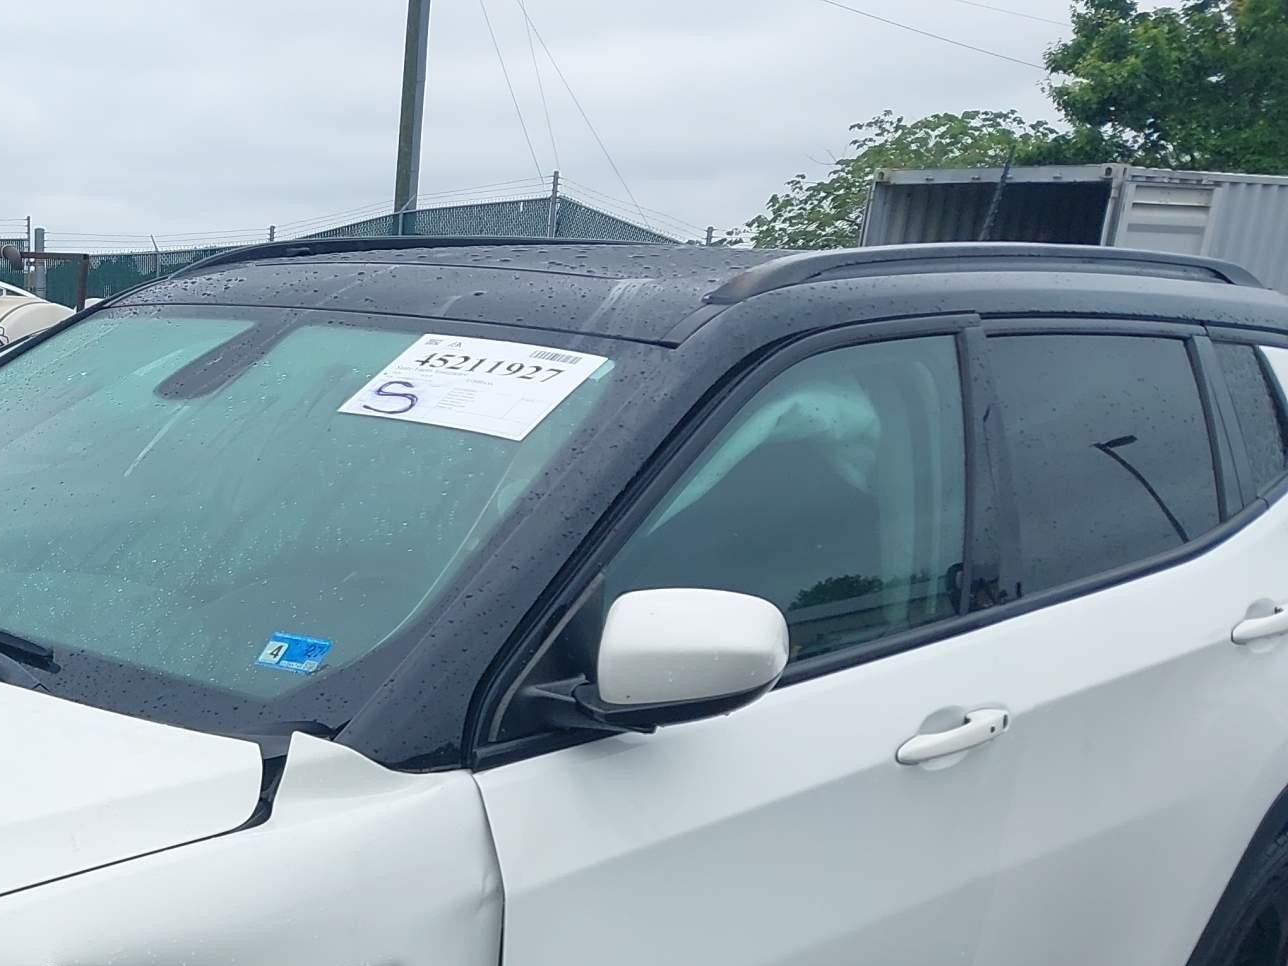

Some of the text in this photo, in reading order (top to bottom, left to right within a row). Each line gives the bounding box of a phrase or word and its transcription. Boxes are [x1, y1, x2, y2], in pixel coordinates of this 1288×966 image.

[415, 352, 567, 383] 45211927
[362, 380, 418, 415] S
[269, 644, 284, 659] 4
